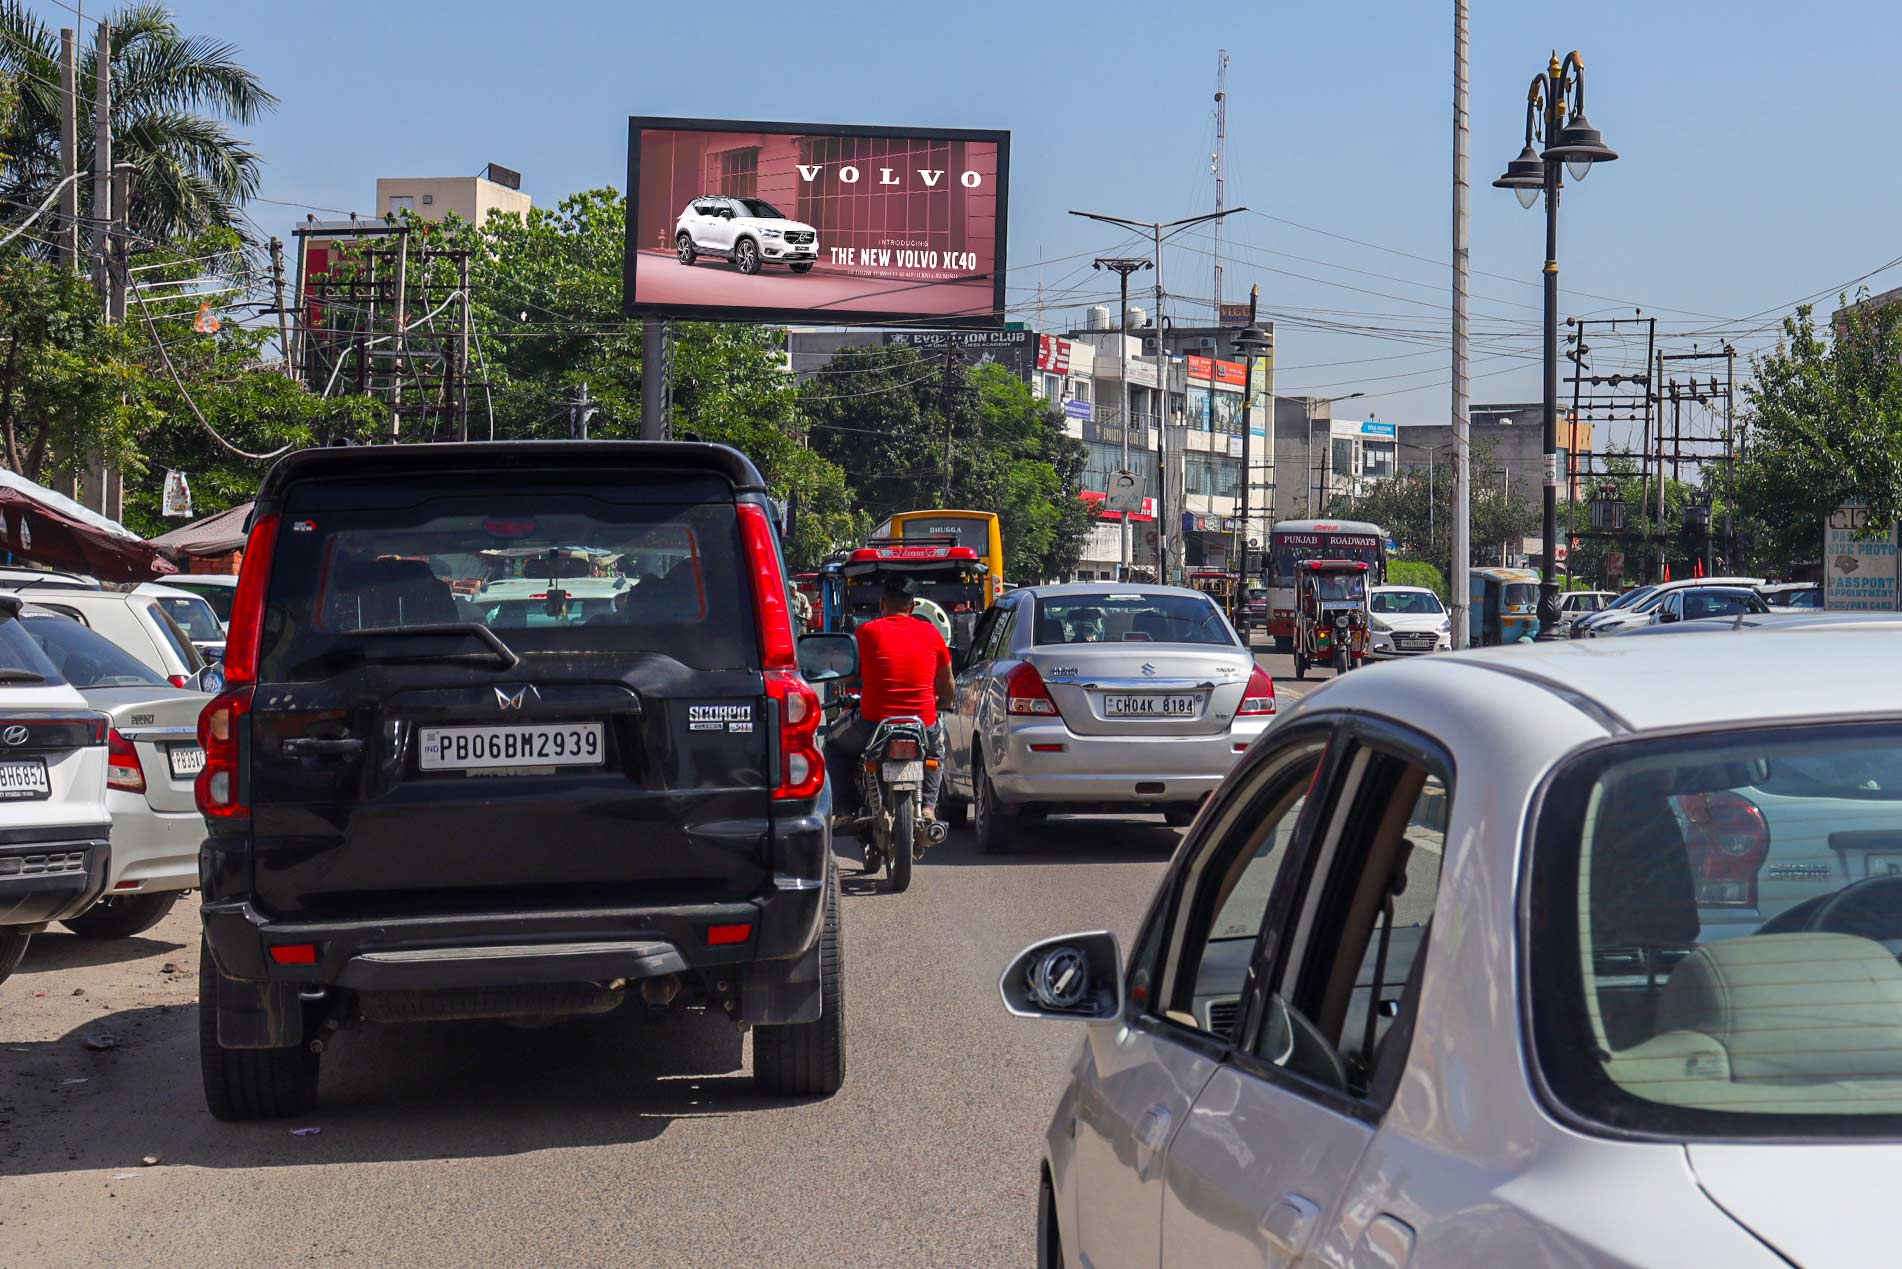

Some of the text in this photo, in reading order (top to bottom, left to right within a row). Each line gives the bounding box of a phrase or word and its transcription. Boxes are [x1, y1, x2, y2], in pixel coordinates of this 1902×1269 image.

[796, 164, 982, 188] VOLVO
[878, 239, 929, 247] INTRODUCING
[830, 247, 976, 270] THE NEW VOLVO XC40
[988, 331, 1025, 343] CLUB
[1284, 535, 1376, 546] PUNJAB ROADWAYS
[1858, 544, 1896, 556] PHOTO
[1829, 577, 1895, 588] PASSPORT
[1116, 698, 1192, 712] CH04K 8184
[688, 705, 751, 721] SCORPIO
[424, 731, 598, 761] IND PB06BM2939
